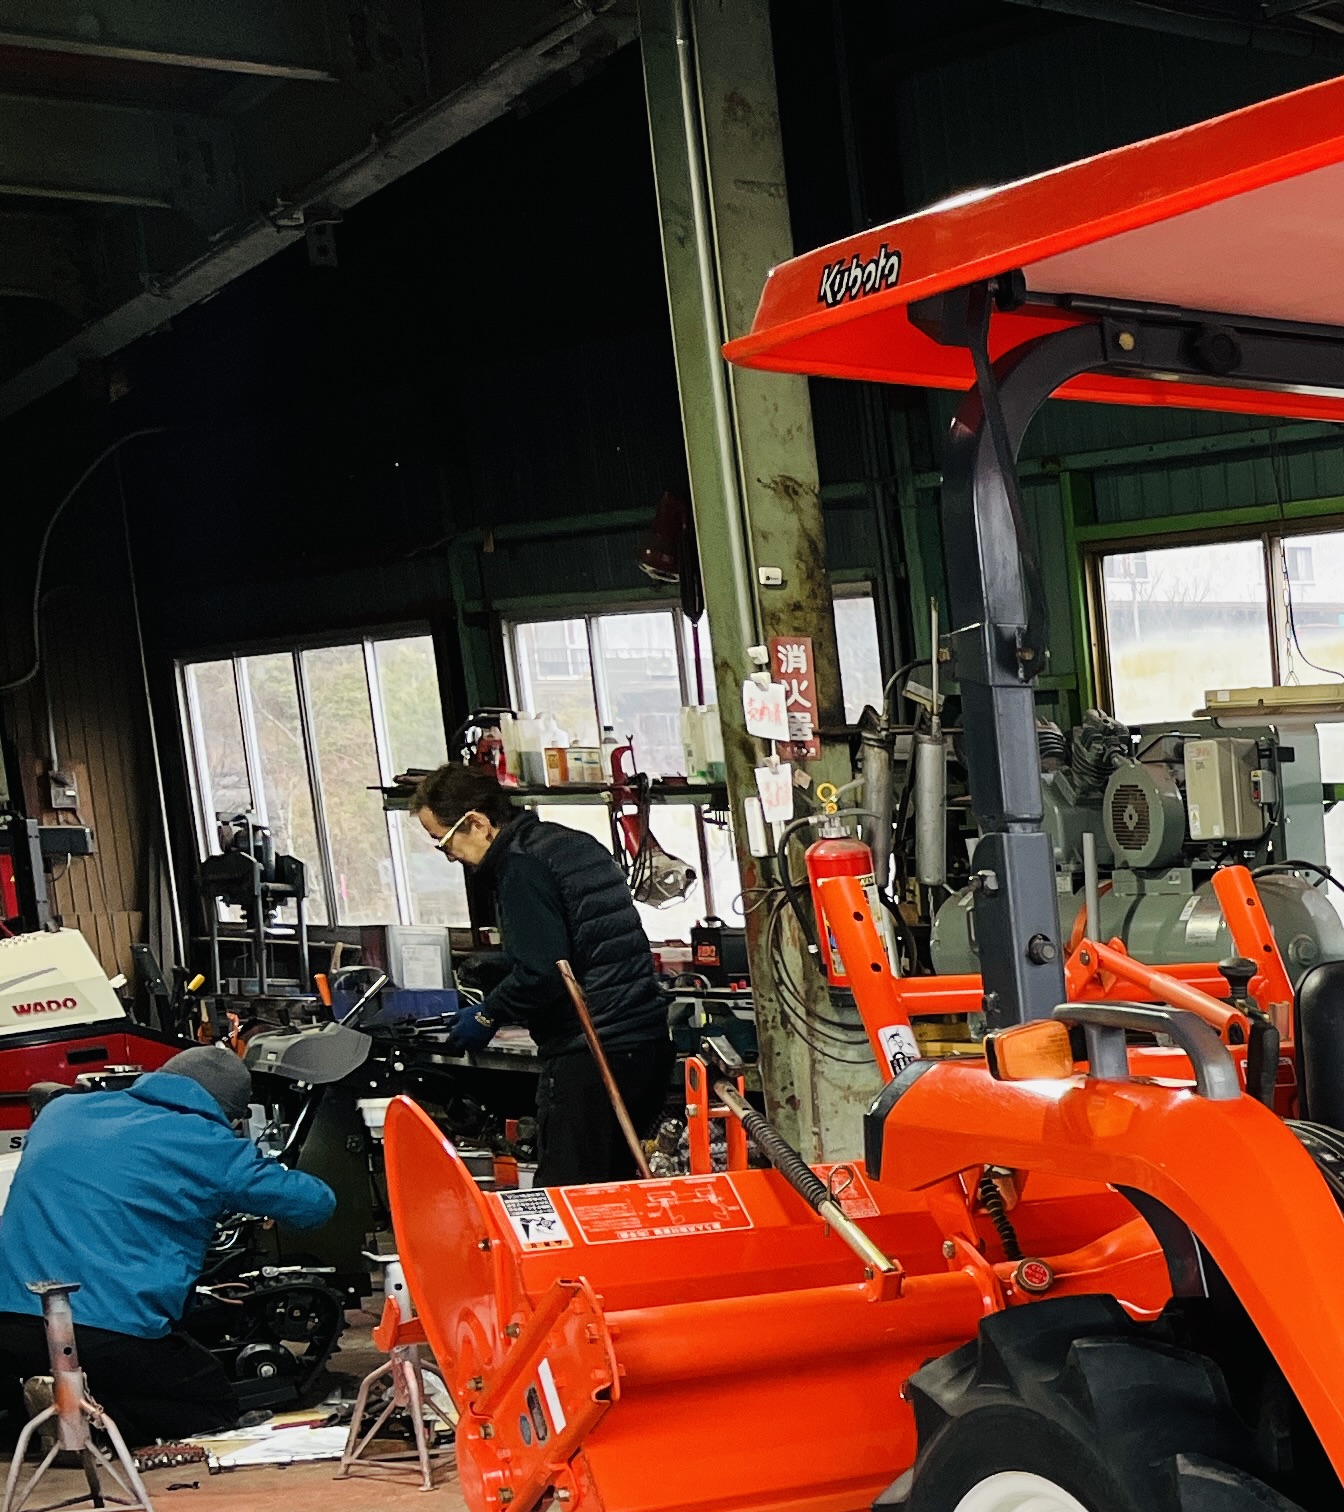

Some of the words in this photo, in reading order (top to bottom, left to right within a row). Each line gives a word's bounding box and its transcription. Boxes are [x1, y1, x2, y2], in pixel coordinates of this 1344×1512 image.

[819, 244, 901, 306] Kubota
[777, 643, 815, 741] 消火器
[11, 997, 79, 1017] WADO
